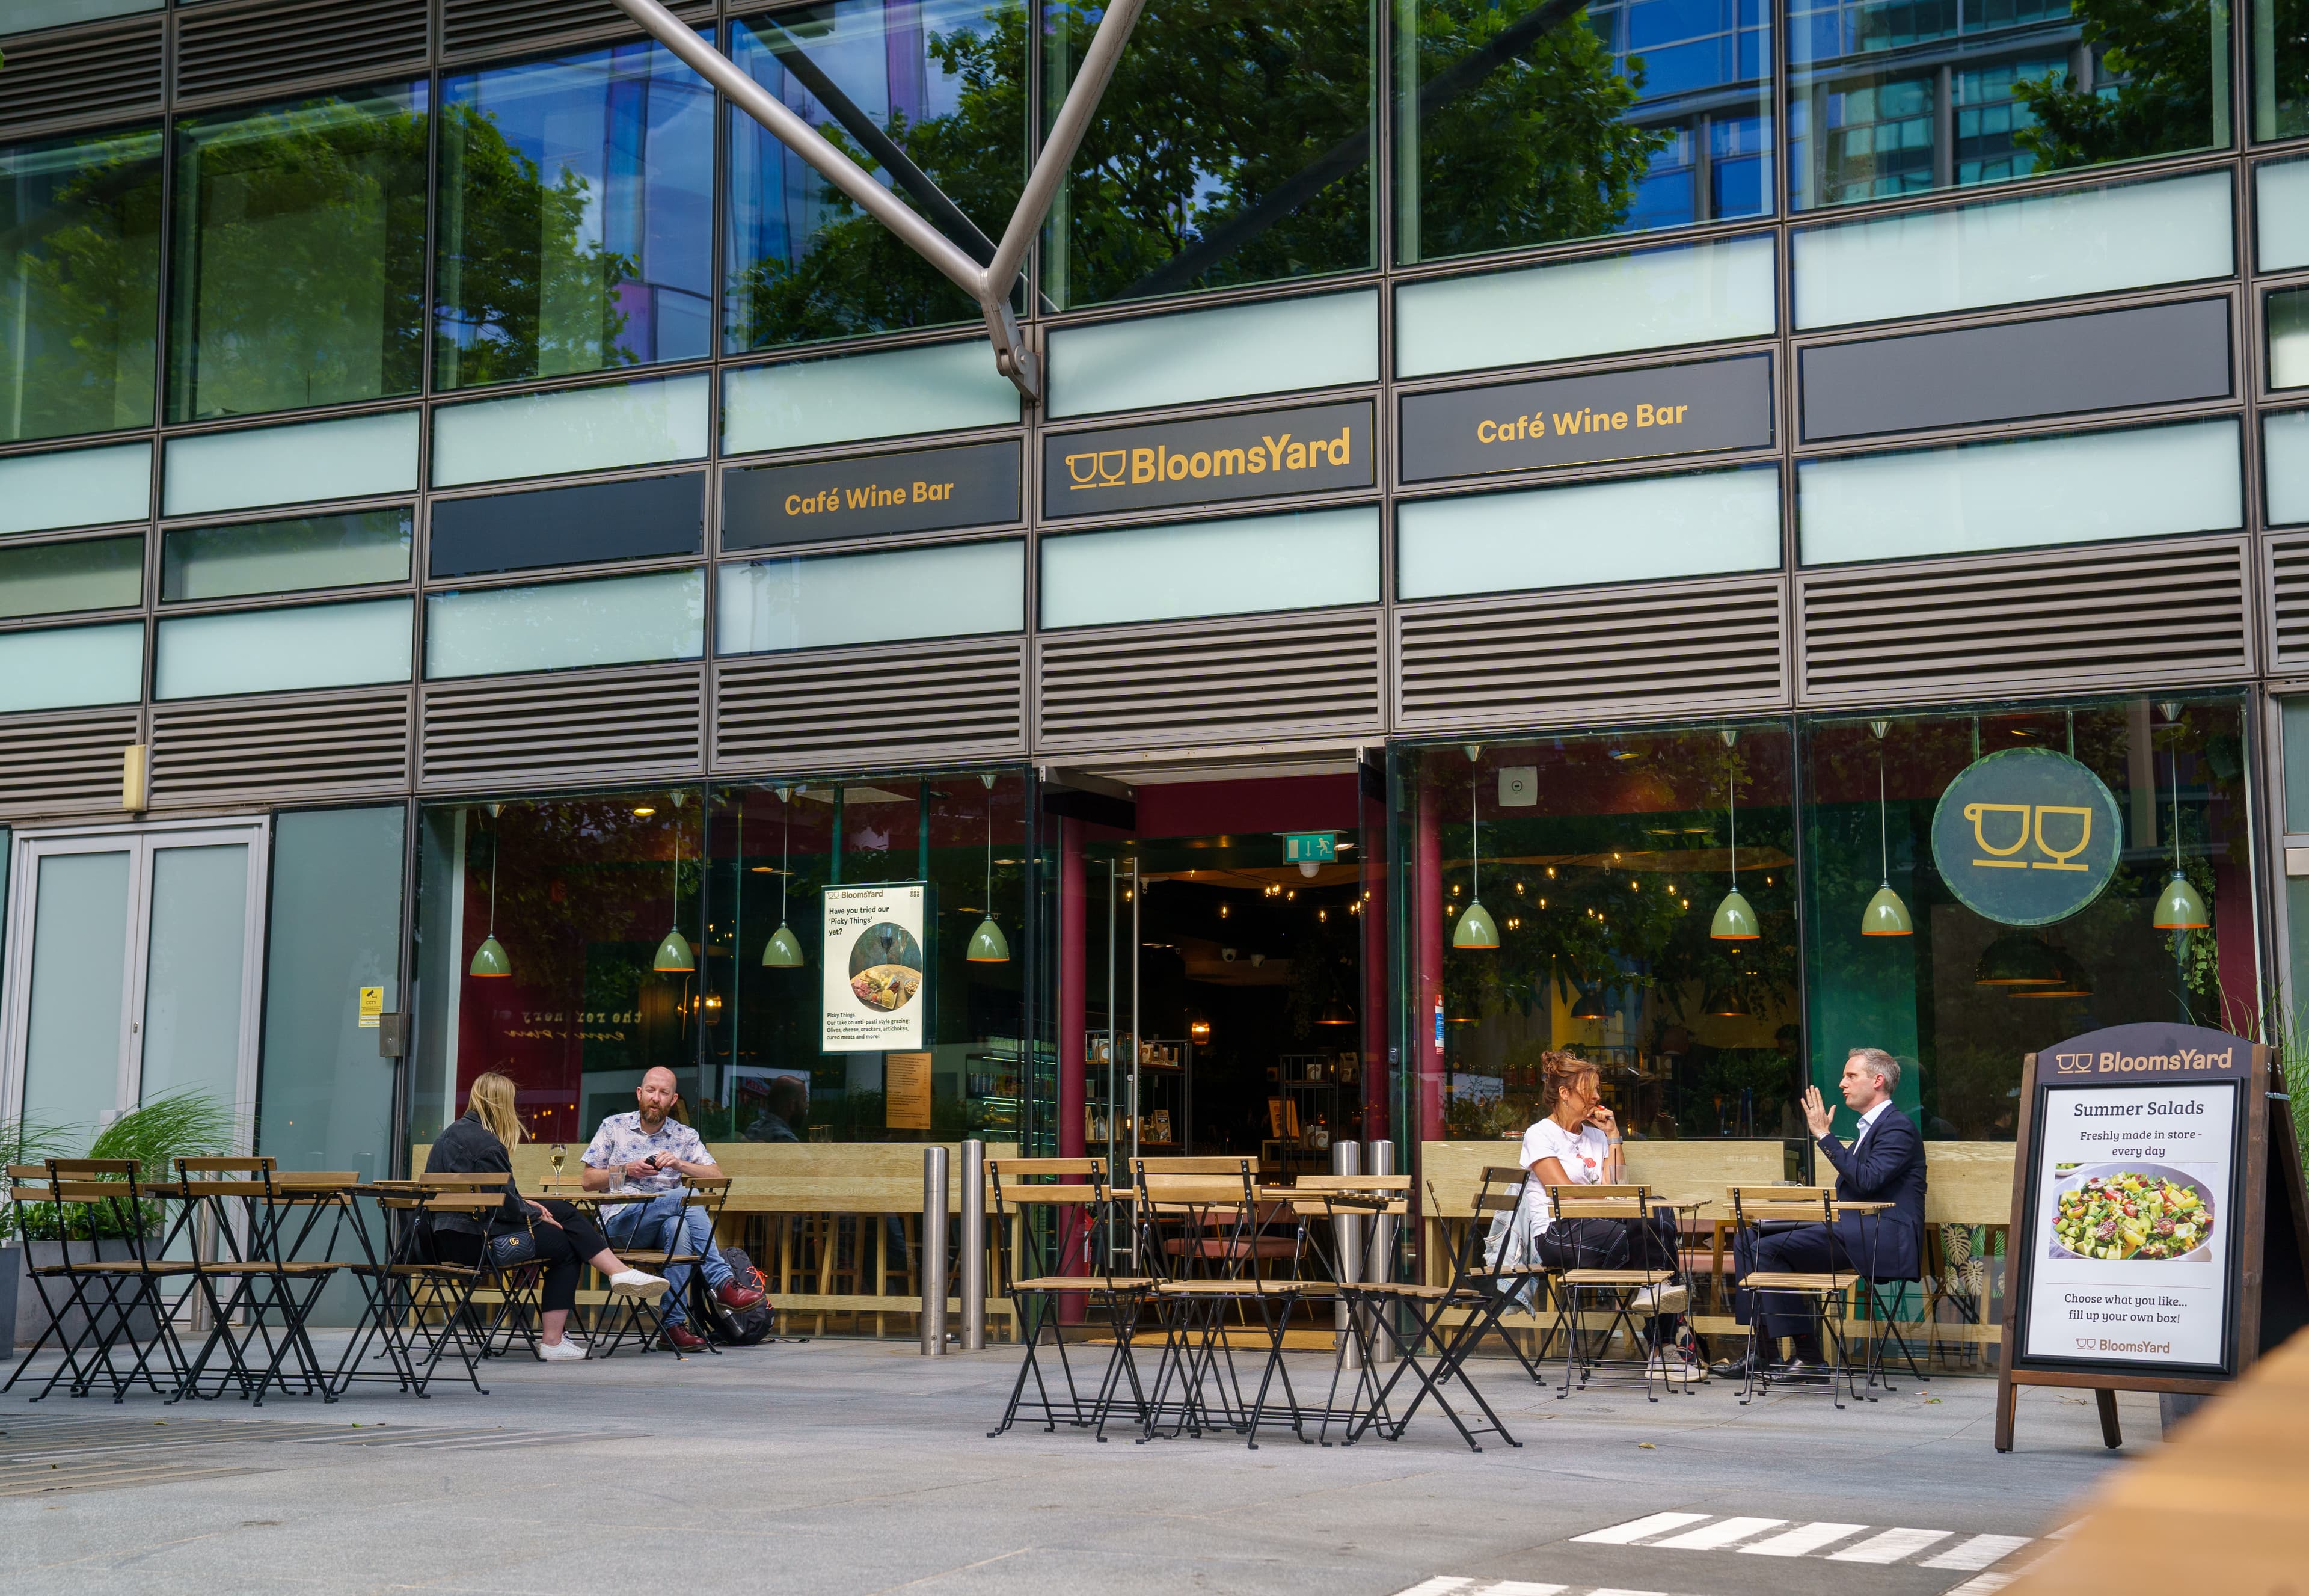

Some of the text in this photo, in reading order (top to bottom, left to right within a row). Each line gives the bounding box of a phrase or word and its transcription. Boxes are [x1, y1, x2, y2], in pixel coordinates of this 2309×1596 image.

[1477, 404, 1688, 443] Café Wine Bar
[1131, 426, 1350, 484] BloomsYard
[785, 482, 954, 515] Café Wine Bar
[841, 890, 883, 899] BloomsYard
[829, 928, 843, 937] yet?
[2099, 1047, 2233, 1073] BloomsYard
[2074, 1100, 2204, 1117] Summer Salads
[2080, 1131, 2120, 1142] Freshly
[2122, 1130, 2151, 1140] made
[2154, 1130, 2165, 1140] in
[2168, 1131, 2195, 1139] store
[2112, 1146, 2165, 1158] every day
[2064, 1294, 2188, 1307] Choose what you like...
[2068, 1310, 2180, 1324] fill up your own box!
[2099, 1339, 2170, 1354] BloomsYard
